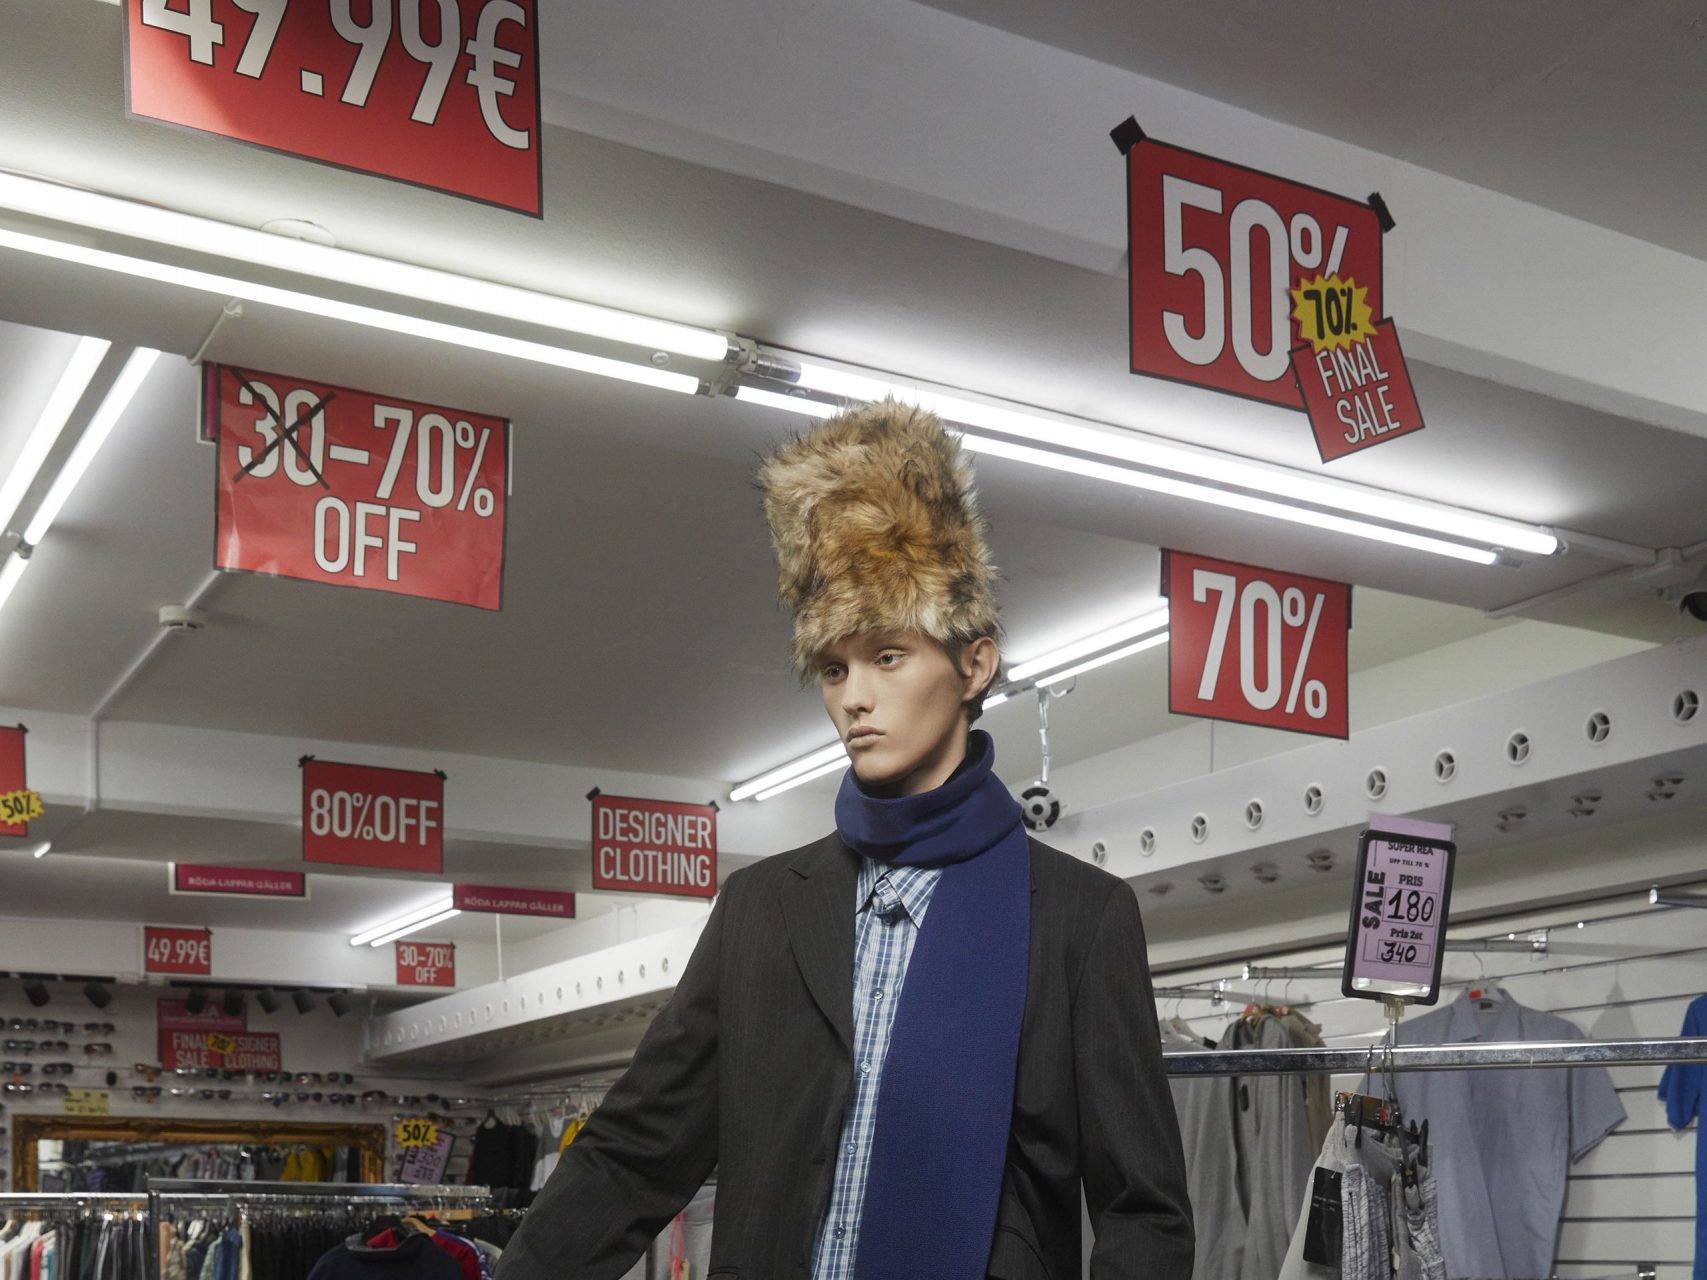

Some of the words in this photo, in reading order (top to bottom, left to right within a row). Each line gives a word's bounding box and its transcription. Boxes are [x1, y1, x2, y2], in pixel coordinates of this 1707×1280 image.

[1303, 287, 1358, 340] 70%
[1316, 337, 1389, 397] FINAL
[1336, 385, 1400, 444] SALE
[313, 495, 421, 581] OFF
[1192, 568, 1328, 719] 70%
[599, 807, 712, 850] DESIGNER
[1388, 841, 1415, 853] SUPER
[1416, 845, 1434, 856] REA
[600, 847, 710, 887] CLOTHING
[1398, 874, 1424, 887] PRIS
[1362, 870, 1385, 930] SALE
[1387, 888, 1435, 922] 180
[1390, 928, 1409, 938] Pris
[1410, 930, 1424, 940] 2st
[148, 938, 209, 965] 49.99€
[1380, 942, 1417, 963] 340
[415, 967, 438, 983] OFF
[172, 1032, 208, 1050] FINAL
[231, 1036, 278, 1053] ESIGNER
[175, 1051, 209, 1069] SALE
[403, 1124, 431, 1143] 50%
